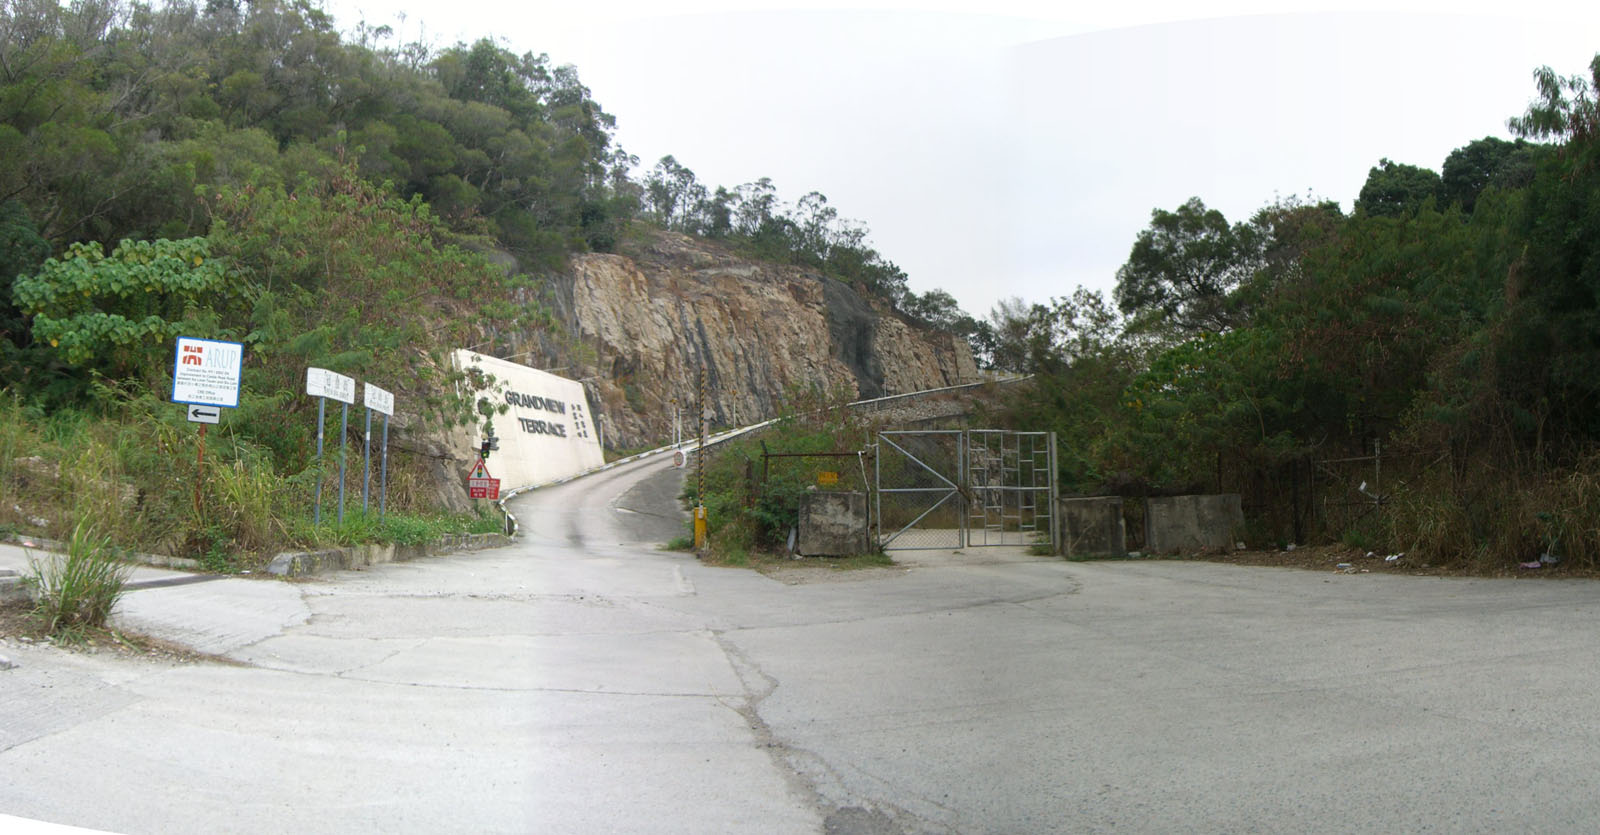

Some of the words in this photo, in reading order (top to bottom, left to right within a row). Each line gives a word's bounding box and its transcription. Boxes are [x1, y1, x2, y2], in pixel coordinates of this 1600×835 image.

[206, 348, 236, 368] ARUP
[505, 390, 565, 414] GRANDVIEW
[518, 417, 567, 438] TERRACE
